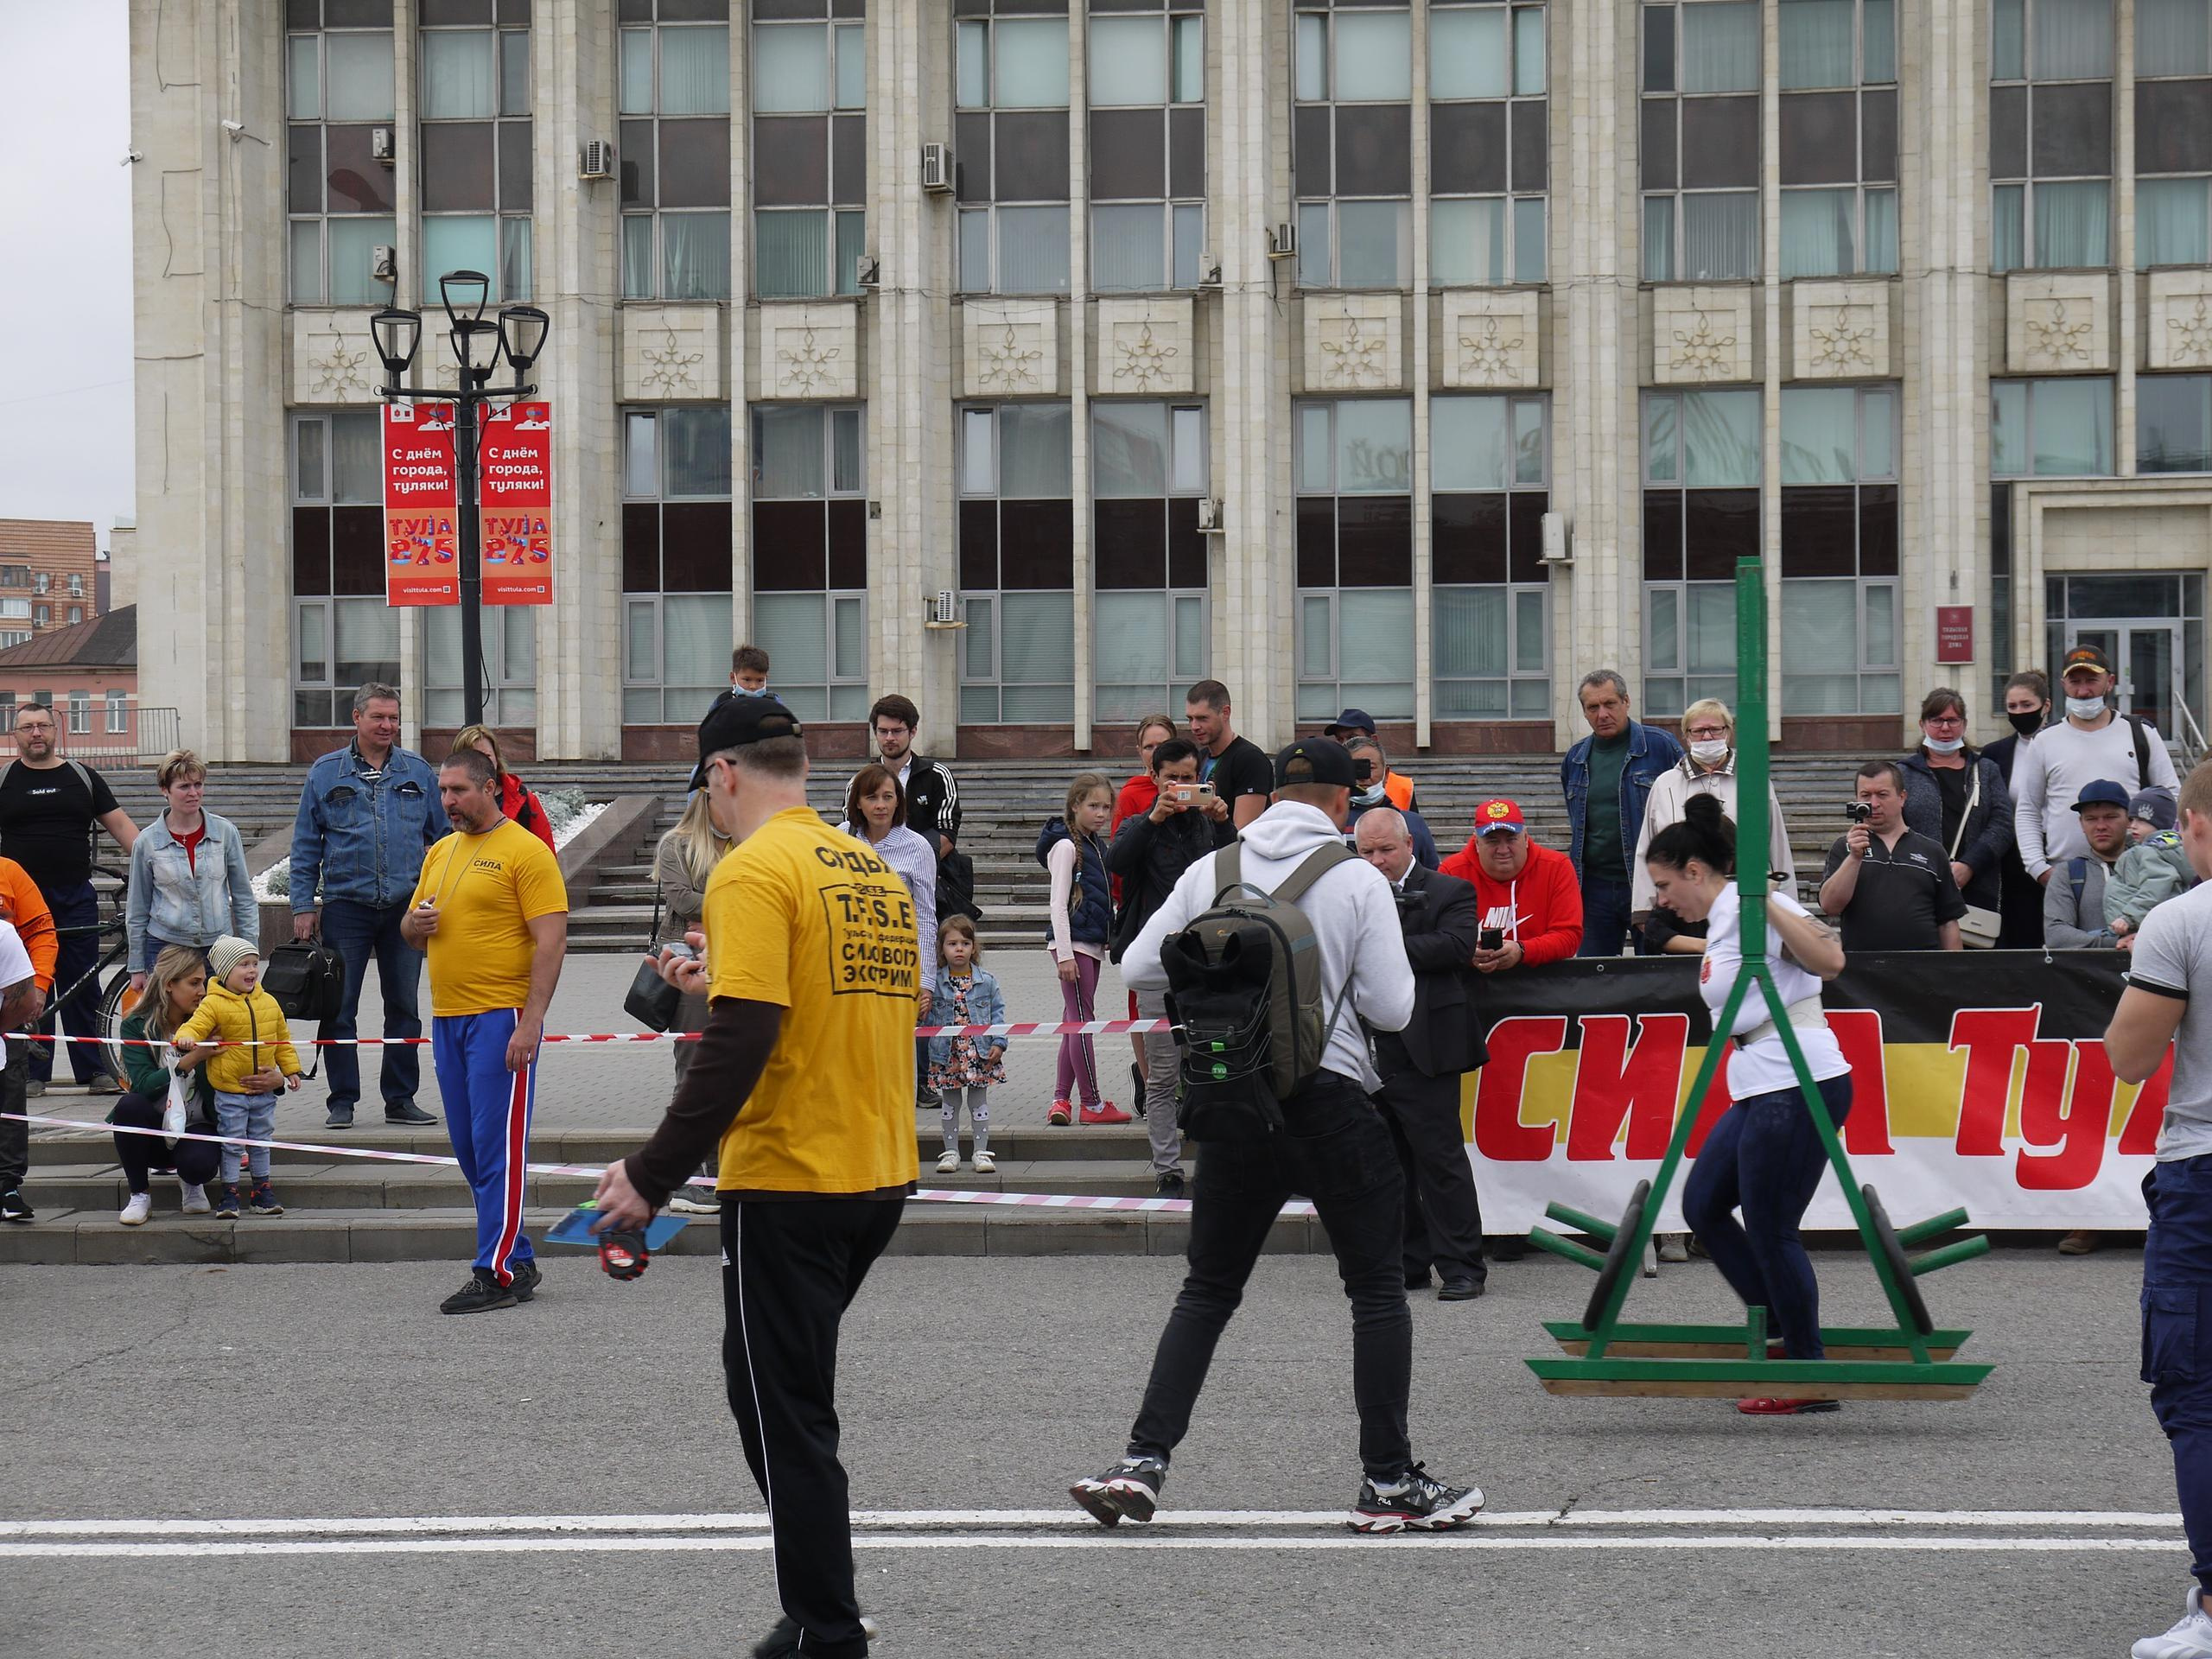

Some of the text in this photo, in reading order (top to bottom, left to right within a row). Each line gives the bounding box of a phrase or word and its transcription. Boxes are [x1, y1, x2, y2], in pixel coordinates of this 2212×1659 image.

[392, 448, 442, 461] С днём
[488, 447, 538, 460] С днём
[392, 466, 448, 477] города,
[489, 465, 543, 476] города,
[392, 480, 448, 494] туляки!
[489, 479, 544, 493] туляки!
[389, 515, 453, 537] ТУЛА
[485, 515, 548, 536] ТУЛА
[389, 537, 454, 566] 875
[484, 536, 549, 565] 875
[474, 860, 501, 870] СИЛА
[1377, 1497, 1392, 1506] FILA
